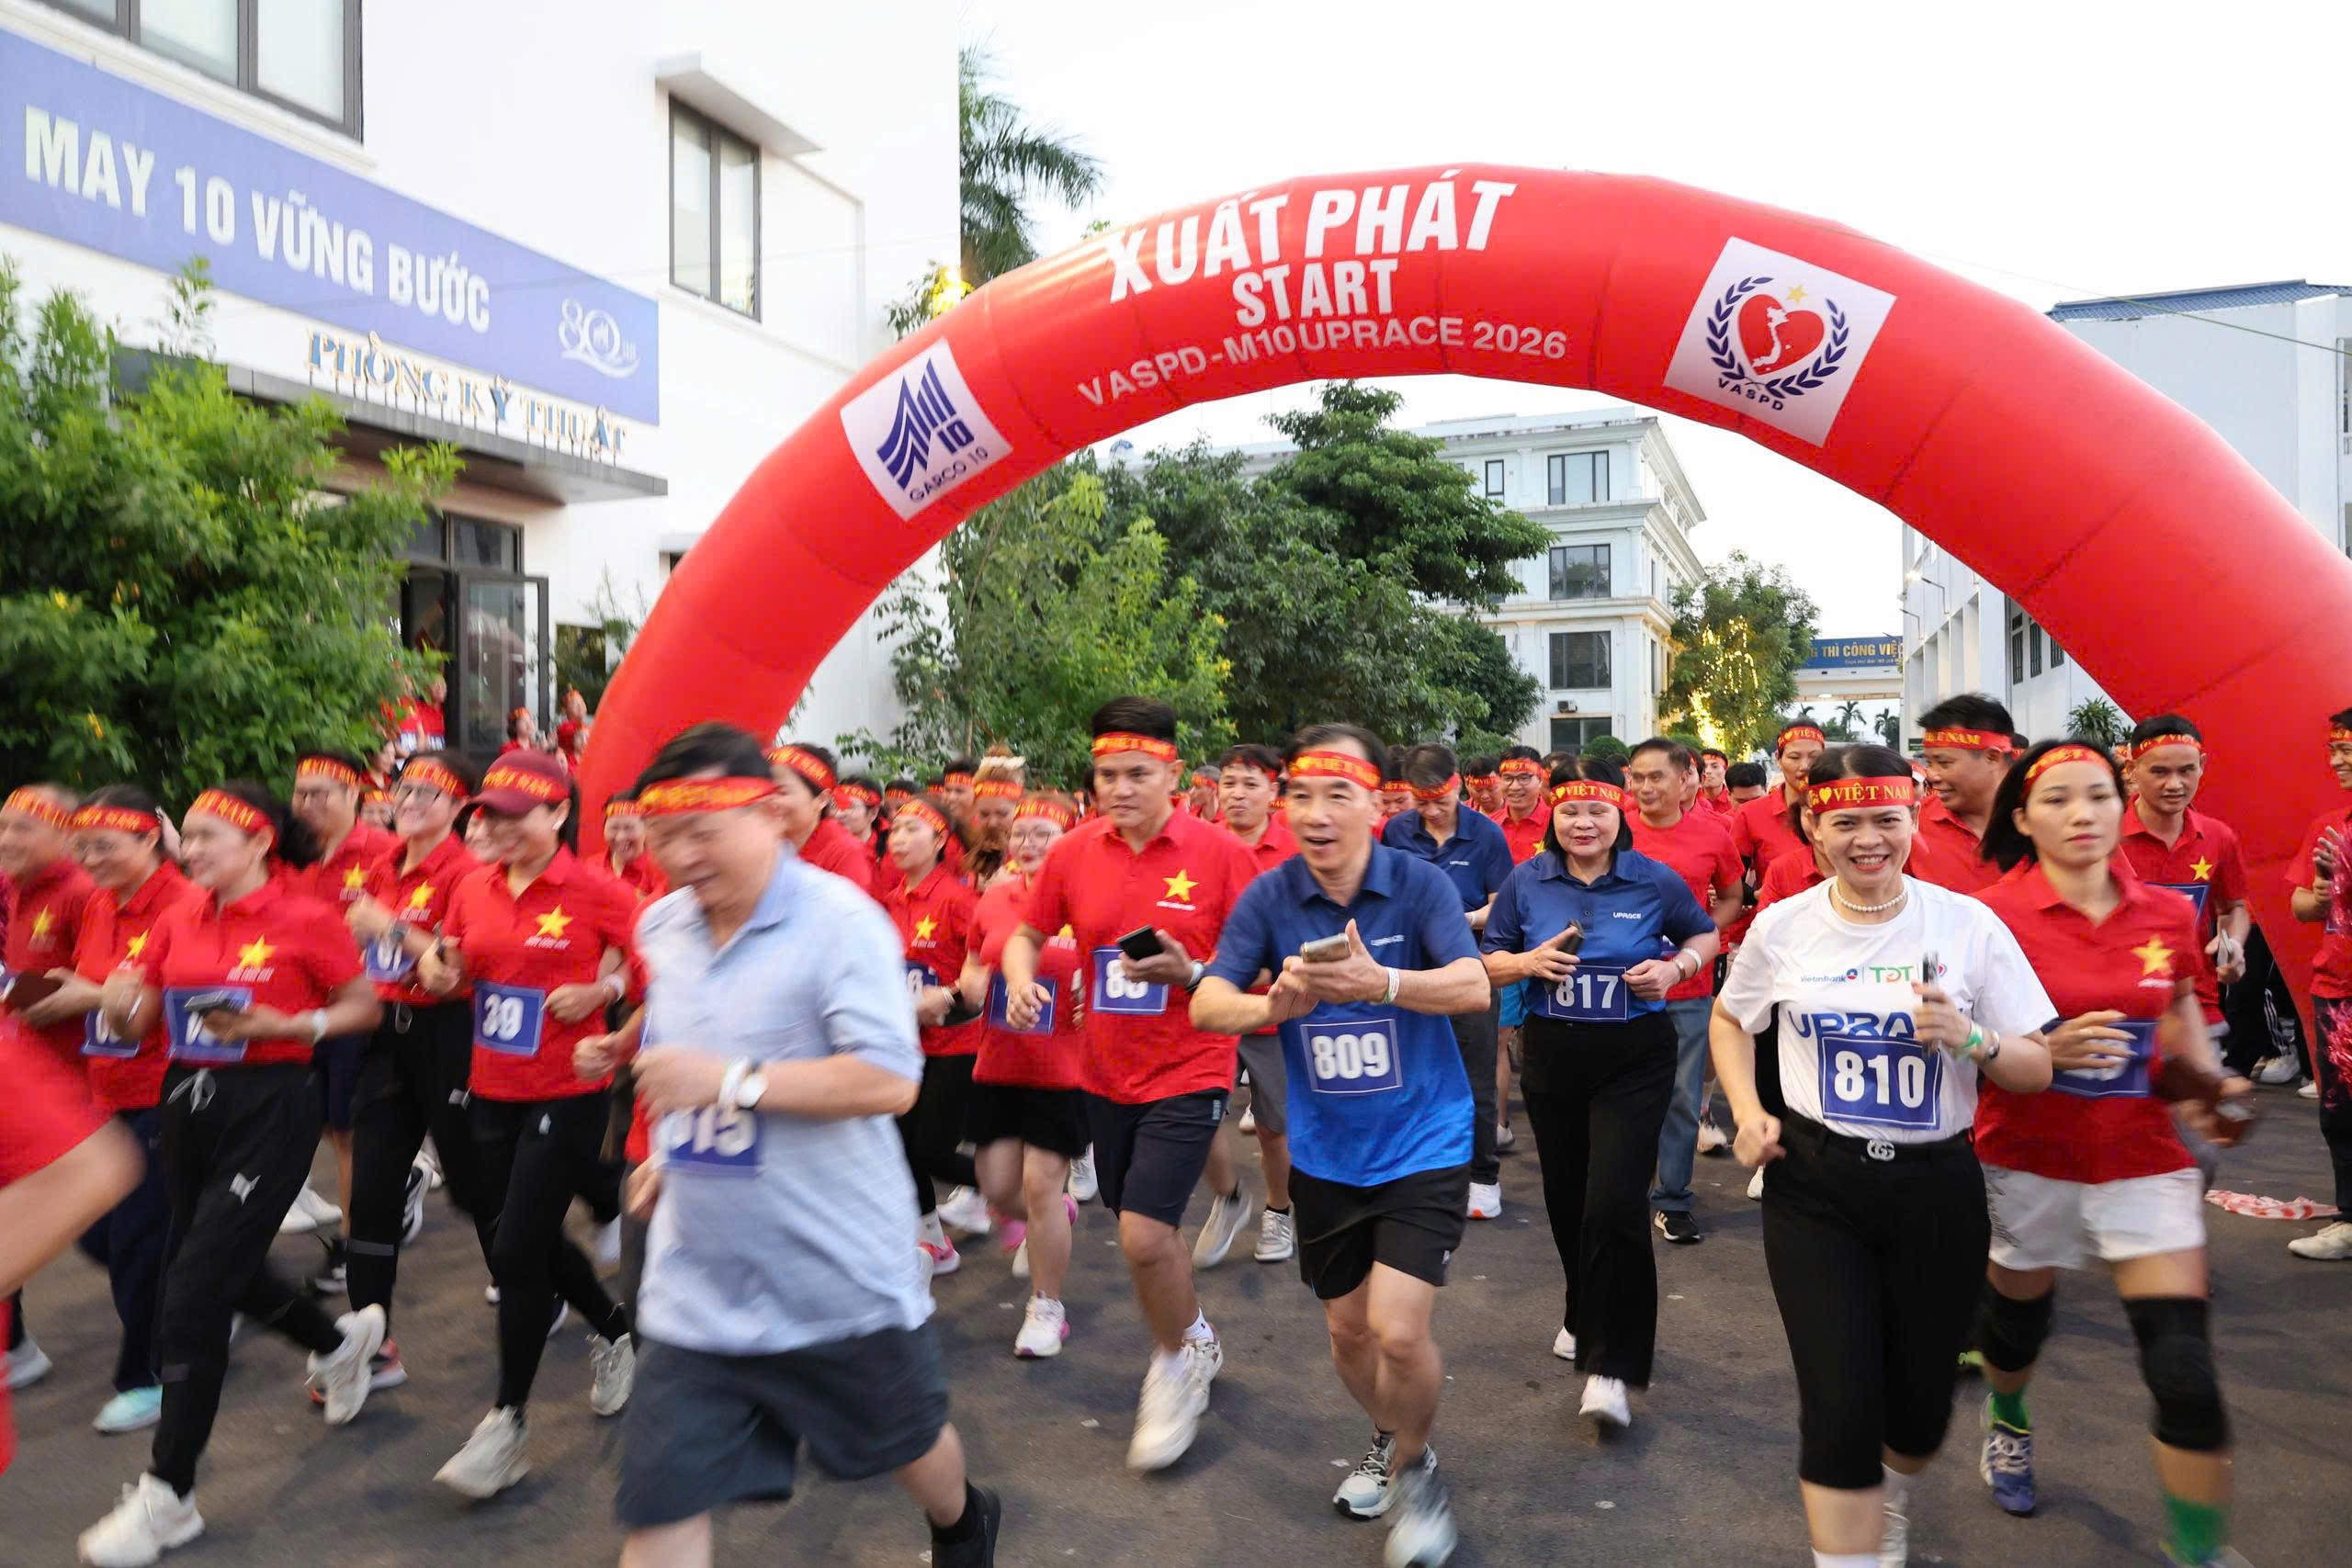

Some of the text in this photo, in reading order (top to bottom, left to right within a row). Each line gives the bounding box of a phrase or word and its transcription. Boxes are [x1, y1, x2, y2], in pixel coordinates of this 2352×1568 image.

[26, 104, 491, 334] MAY 10 VỮNG BƯỚC
[1104, 169, 1518, 304] XUẤT PHÁT
[1232, 257, 1398, 327] START
[1473, 321, 1567, 359] 2026
[306, 331, 449, 403] PHÒNG
[459, 373, 514, 422] KỸ
[1718, 378, 1784, 411] VASPD
[937, 419, 975, 455] 10
[910, 446, 989, 503] GARCO 10
[1843, 641, 1876, 658] CÔNG
[1566, 783, 1622, 803] VIỆT NAM
[1833, 782, 1880, 804] VIỆT
[1883, 785, 1912, 801] NAM
[1555, 974, 1620, 1009] 817
[1311, 1032, 1390, 1080] 809
[1834, 1050, 1927, 1109] 810
